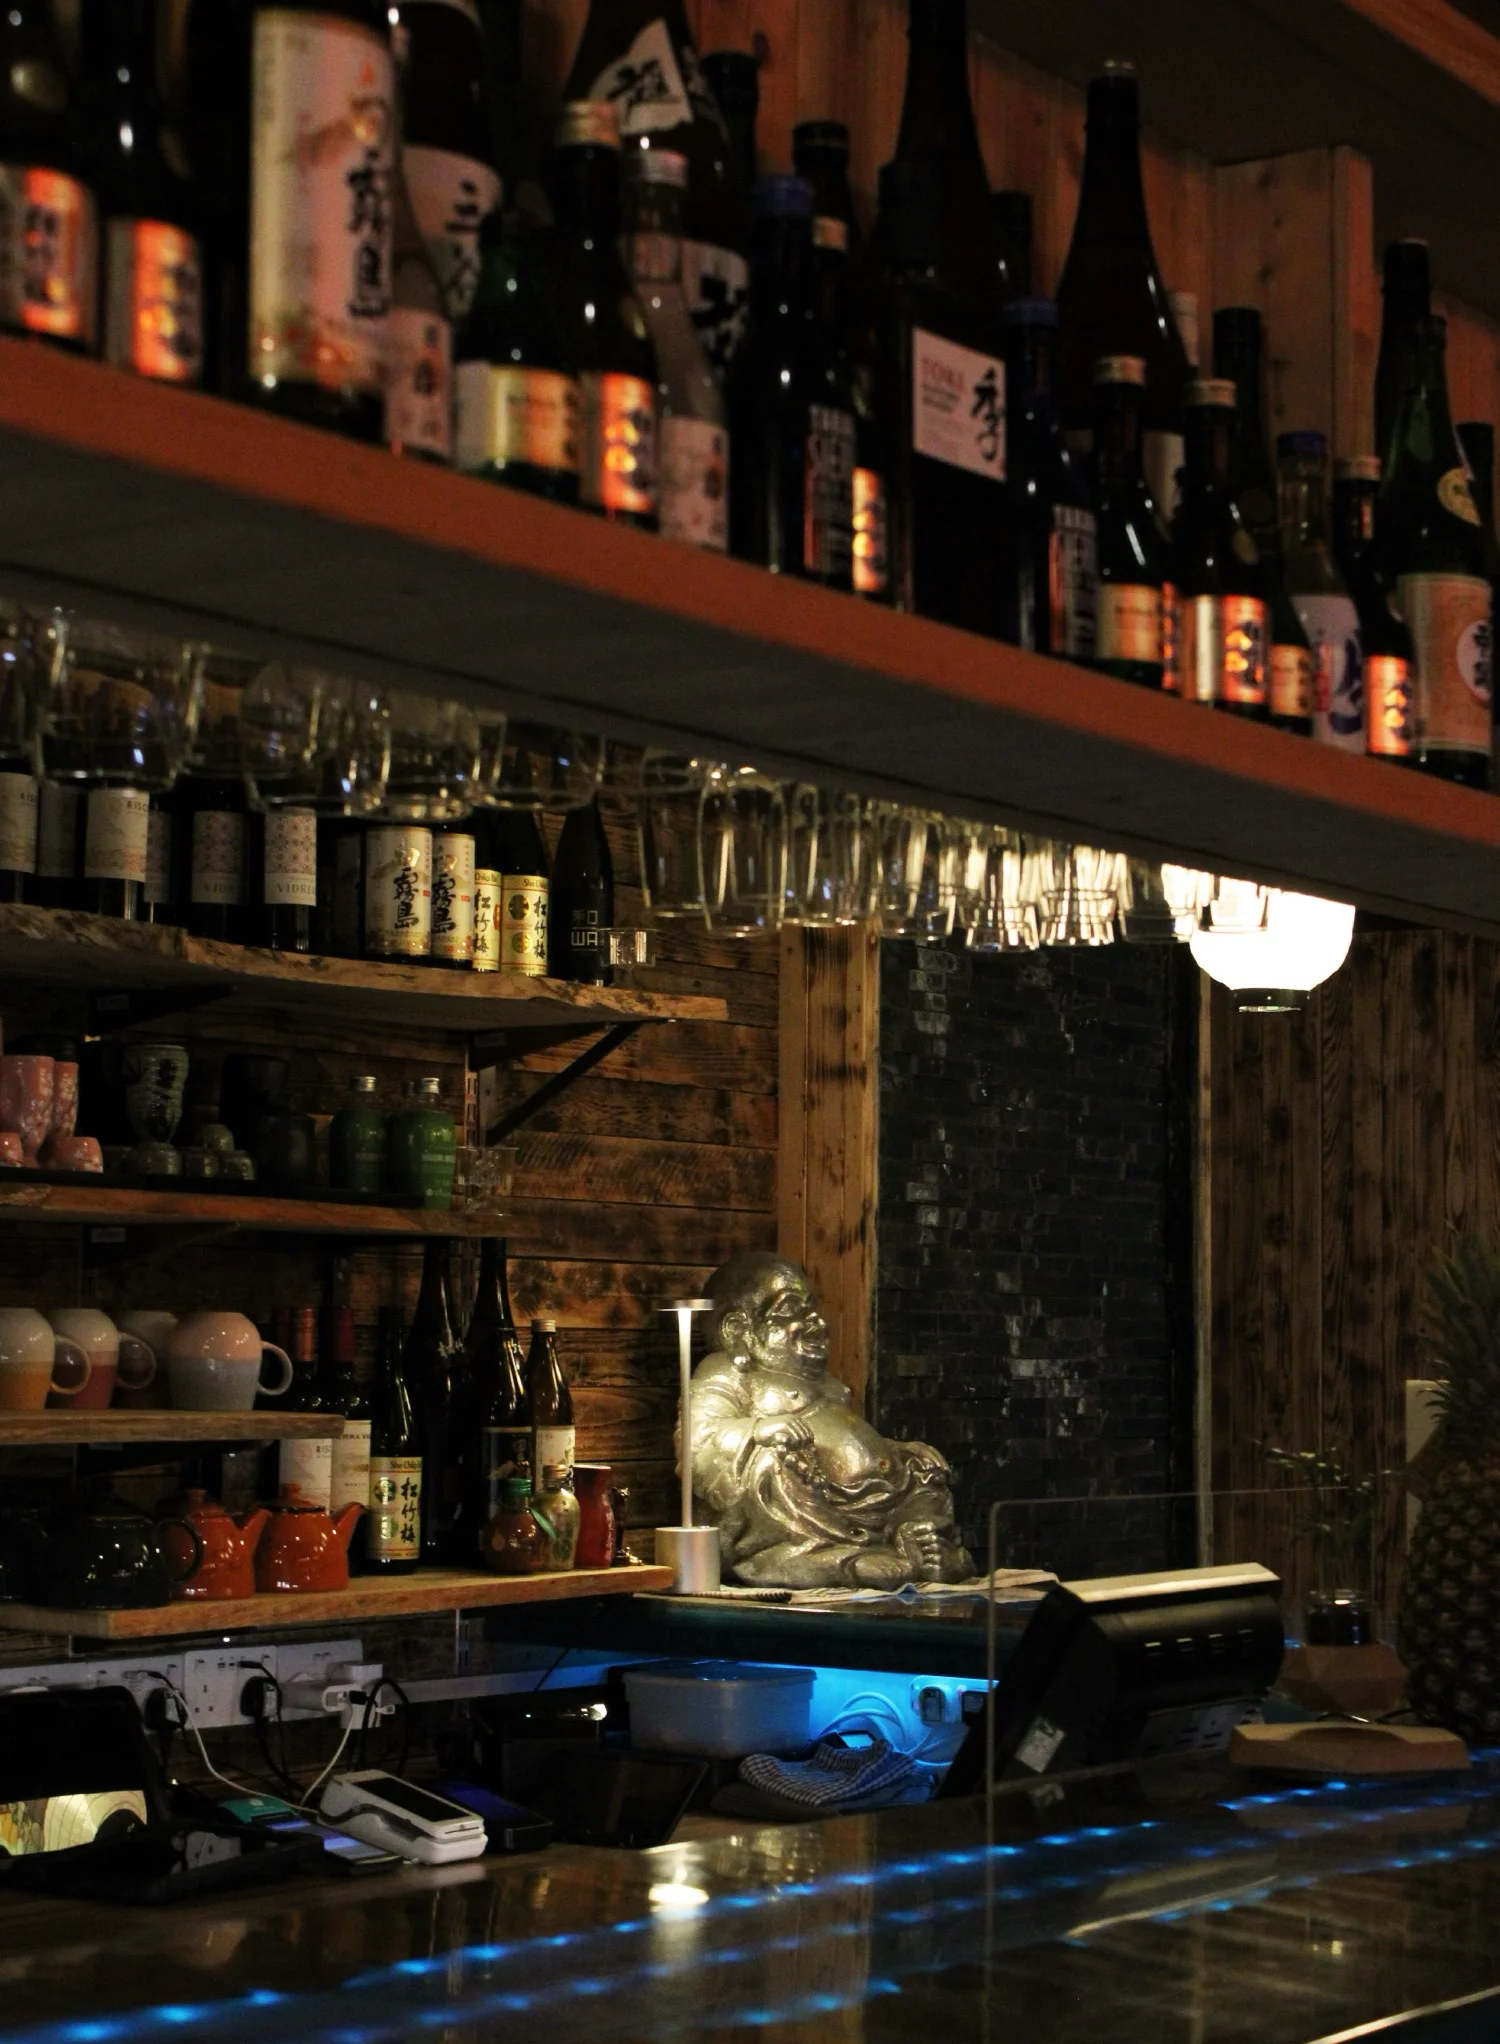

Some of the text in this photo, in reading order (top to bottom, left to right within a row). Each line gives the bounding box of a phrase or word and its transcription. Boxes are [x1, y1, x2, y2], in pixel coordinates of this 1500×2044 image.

[533, 895, 548, 960] 松竹梅
[570, 931, 599, 947] WA
[400, 1476, 418, 1544] 松竹梅
